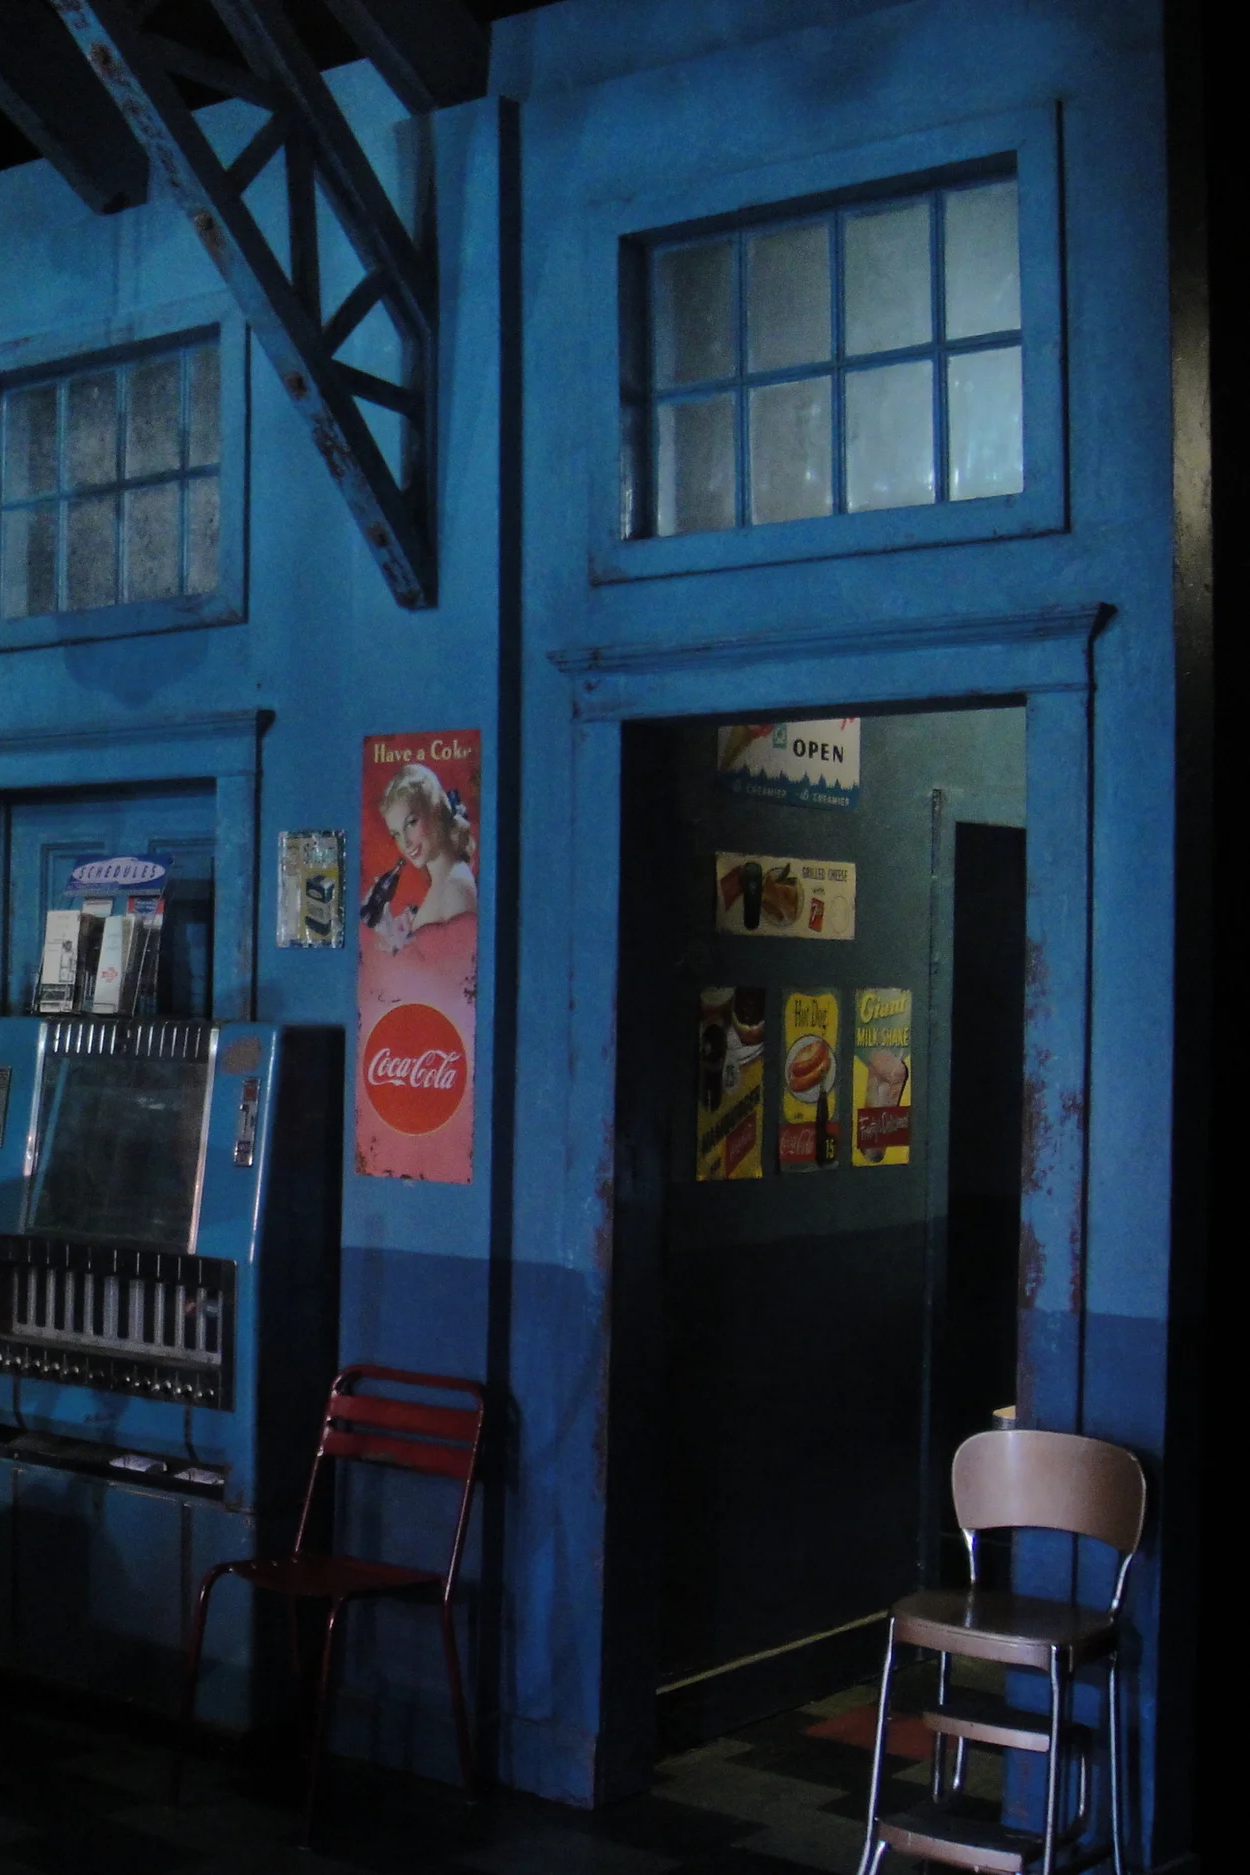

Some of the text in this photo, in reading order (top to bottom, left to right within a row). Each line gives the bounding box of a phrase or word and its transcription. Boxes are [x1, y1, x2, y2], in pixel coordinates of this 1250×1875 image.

[373, 743, 412, 763] Have
[416, 748, 427, 761] a
[793, 738, 845, 764] OPEN
[79, 863, 158, 881] SCHEDULES
[794, 999, 809, 1029] Hot
[367, 1047, 462, 1090] Coca-Cola
